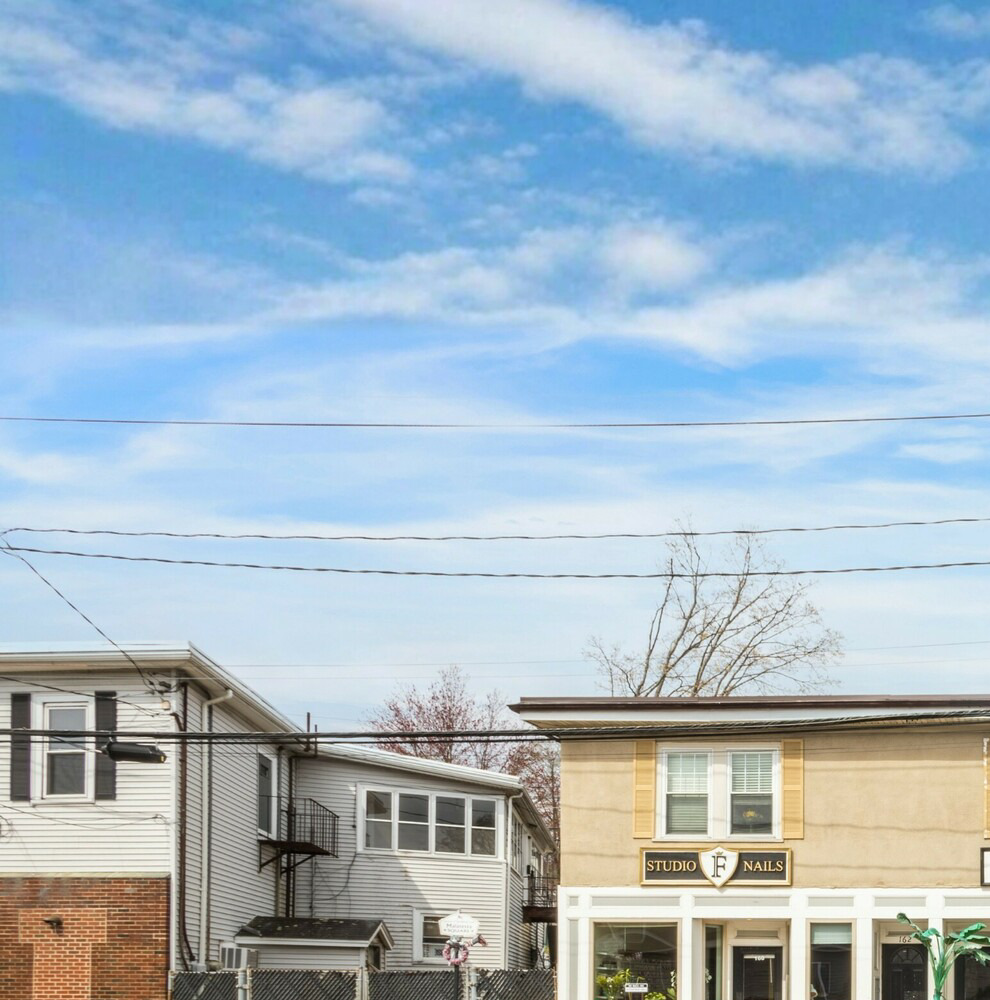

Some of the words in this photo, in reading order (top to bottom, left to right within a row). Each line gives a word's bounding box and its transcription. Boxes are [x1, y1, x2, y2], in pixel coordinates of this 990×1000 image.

[647, 861, 696, 872] STUDIO
[712, 855, 727, 878] F
[744, 861, 784, 872] NAILS
